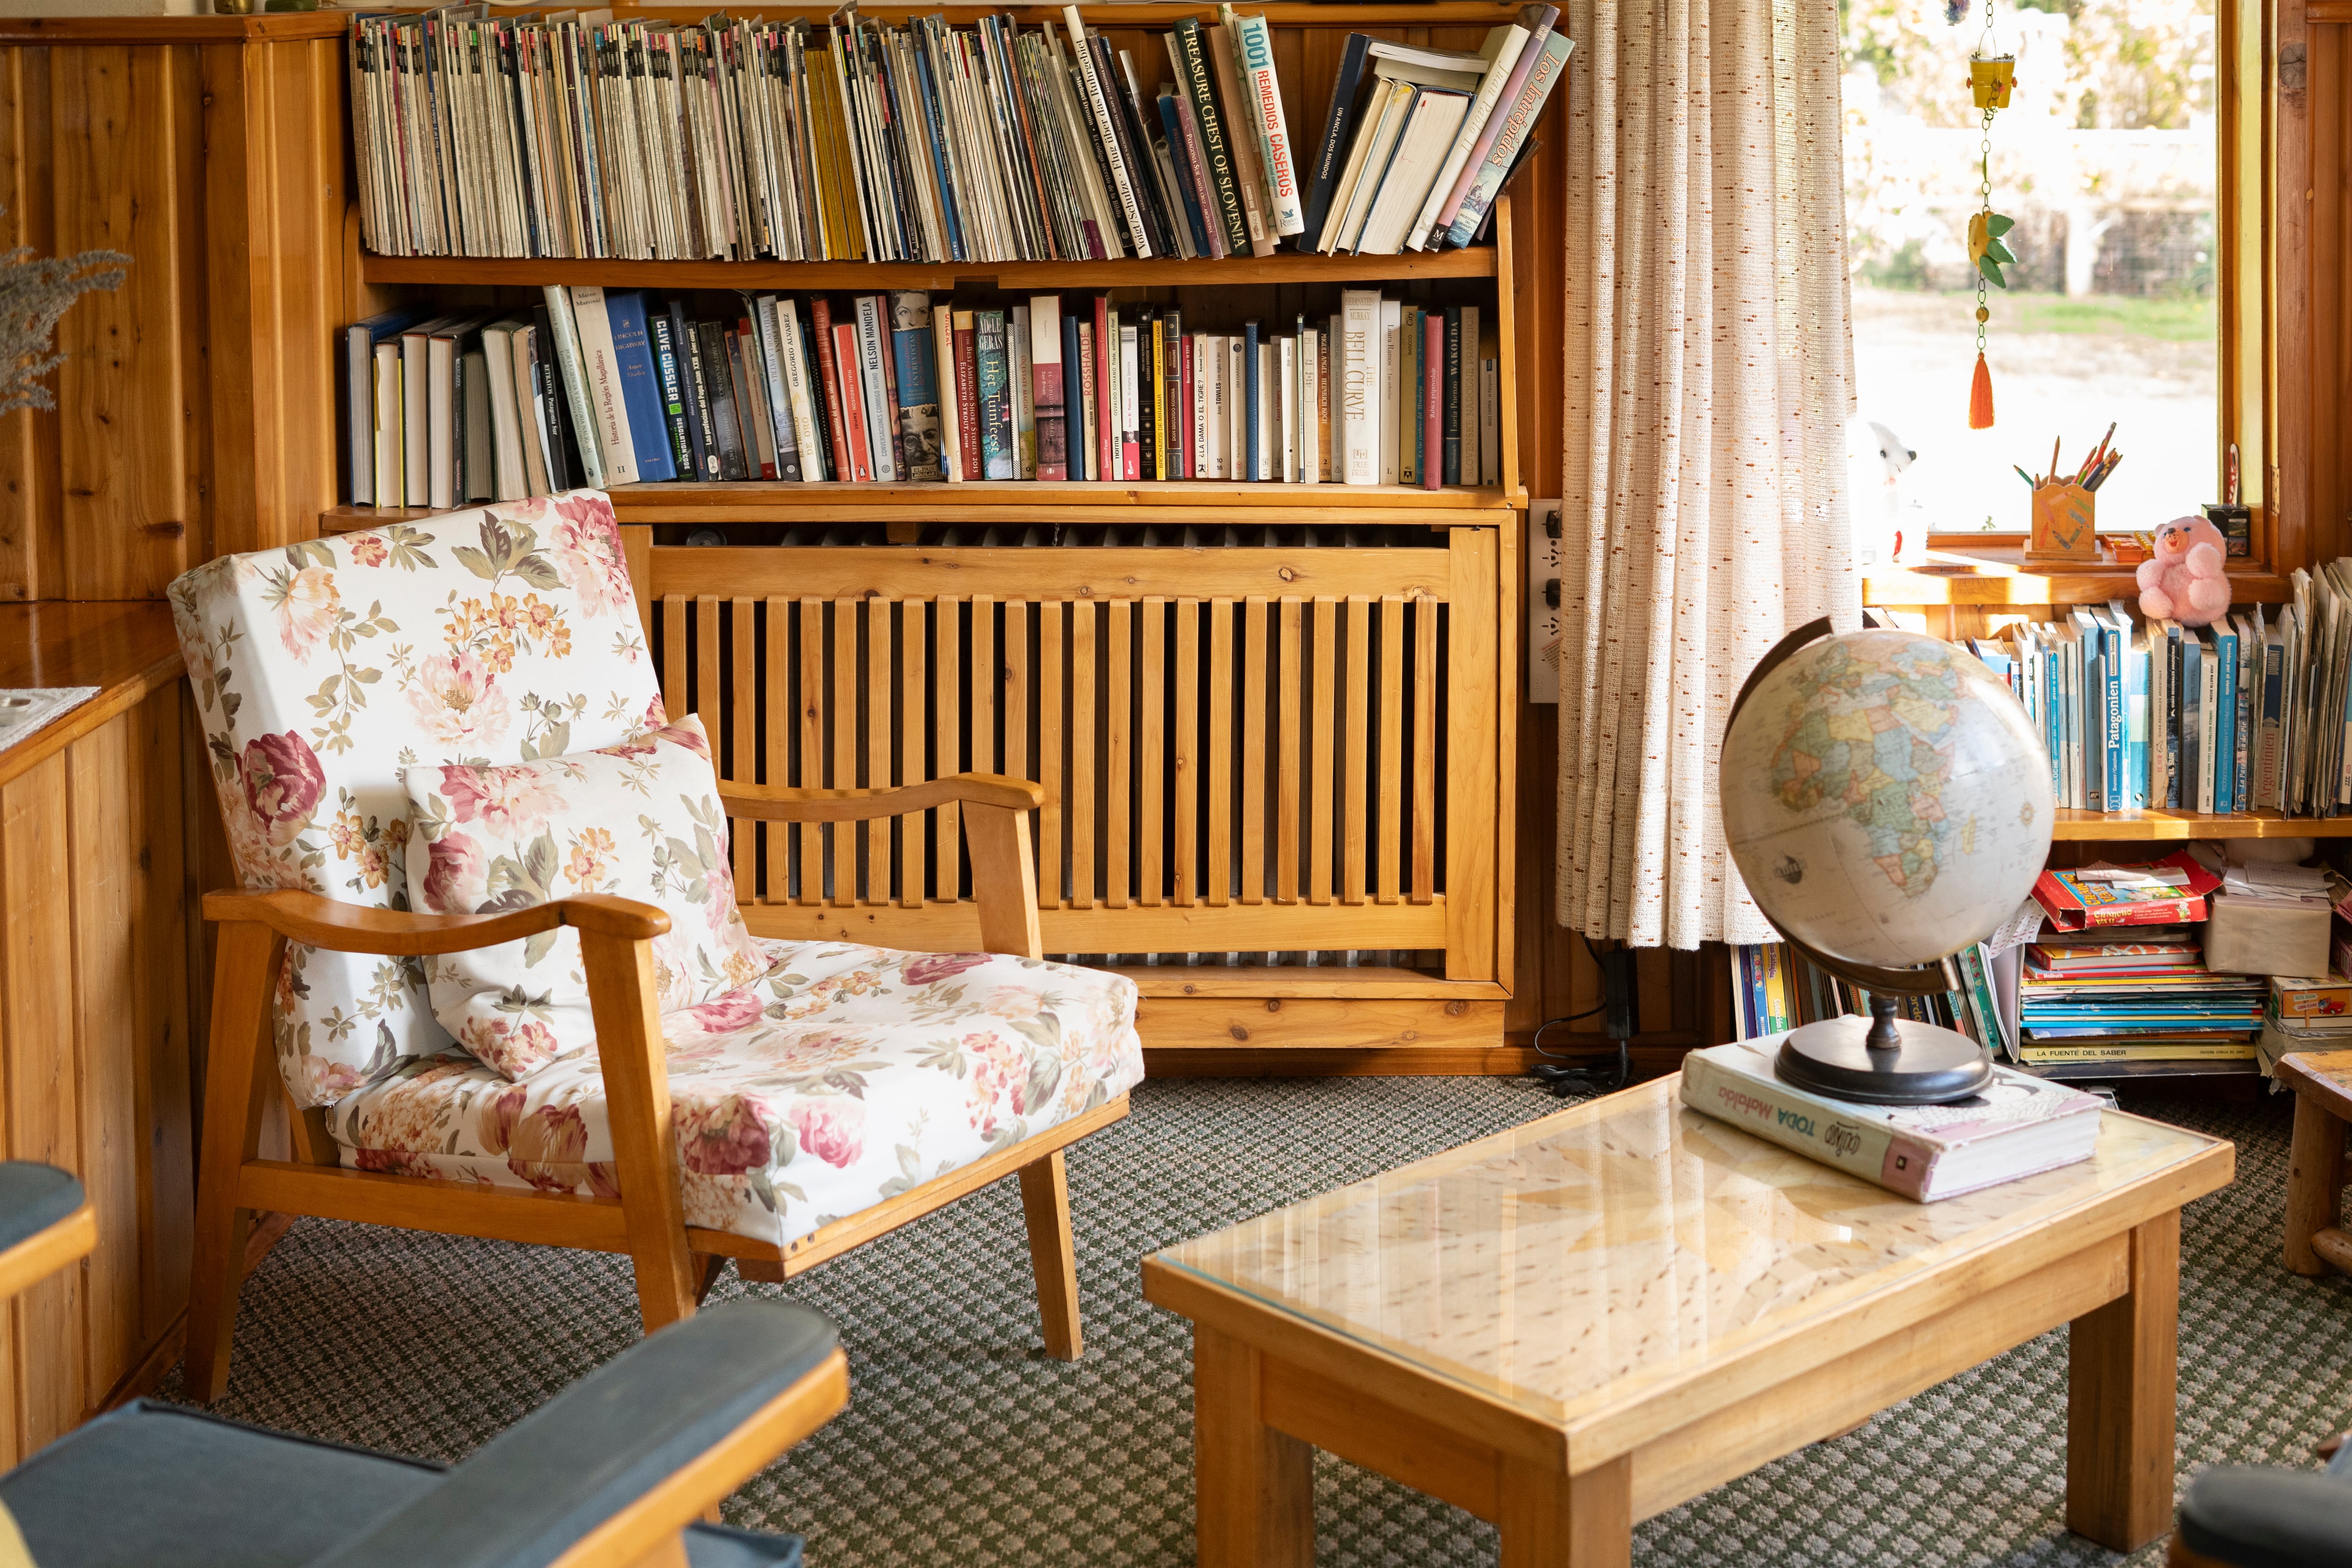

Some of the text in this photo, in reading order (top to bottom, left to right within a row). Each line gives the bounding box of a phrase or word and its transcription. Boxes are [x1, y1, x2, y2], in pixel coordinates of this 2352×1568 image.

[1330, 117, 1340, 138] ANCLA,
[1336, 107, 1343, 117] UN
[1461, 60, 1509, 153] Juan Pablo II
[1492, 50, 1561, 167] Los Intrépidos
[1074, 39, 1146, 249] Voigt/Schulze Flug über das Ruhrgebiet
[1075, 75, 1088, 100] Michael
[1082, 101, 1095, 126] Drosnin
[1094, 142, 1105, 161] código
[1101, 162, 1112, 183] secreto
[1112, 199, 1122, 217] Biblia
[1182, 25, 1247, 248] TREASURE CHEST OF SLOVENIA
[1251, 73, 1262, 103] Tratamientos
[1257, 104, 1265, 123] confiables
[1262, 134, 1271, 155] problemas
[1271, 176, 1279, 198] cotidianos
[1257, 70, 1293, 197] REMEDIOS CASEROS
[1186, 133, 1198, 163] PATAGONIA
[1203, 208, 1212, 233] ARGENTINA
[1320, 152, 1332, 179] MUNDOS
[614, 330, 644, 340] LINCOLN
[615, 340, 645, 350] HIGHWAY
[769, 303, 781, 352] FELIPE PIGNA
[783, 313, 799, 387] GREGORIO ALVAREZ
[862, 302, 878, 369] NELSON MANDELA
[979, 334, 1003, 350] GERAS
[544, 364, 553, 394] RETRATOS
[594, 350, 609, 384] Magallánica
[656, 320, 679, 401] CLIVE CUSSLER
[1080, 332, 1092, 396] ROSSHALDE
[1344, 331, 1365, 421] BELL CURVE
[547, 398, 556, 424] Patagonia
[601, 385, 612, 405] Región
[874, 390, 882, 413] CONMIGO
[986, 361, 1002, 452] Het Tuinfeest
[1465, 314, 1475, 477] SLOVENSKE NARODNE PRAVLJICE
[608, 421, 620, 445] Historia
[676, 418, 687, 453] DESOLATION
[876, 414, 887, 456] CONVERSACIONES
[2267, 649, 2280, 675] DUMONT
[2107, 681, 2122, 748] Patagonien
[2260, 732, 2276, 799] Argentinien
[1768, 954, 1776, 978] Salvajes
[1718, 1086, 1773, 1120] Mafalda
[1777, 1107, 1815, 1137] TODA
